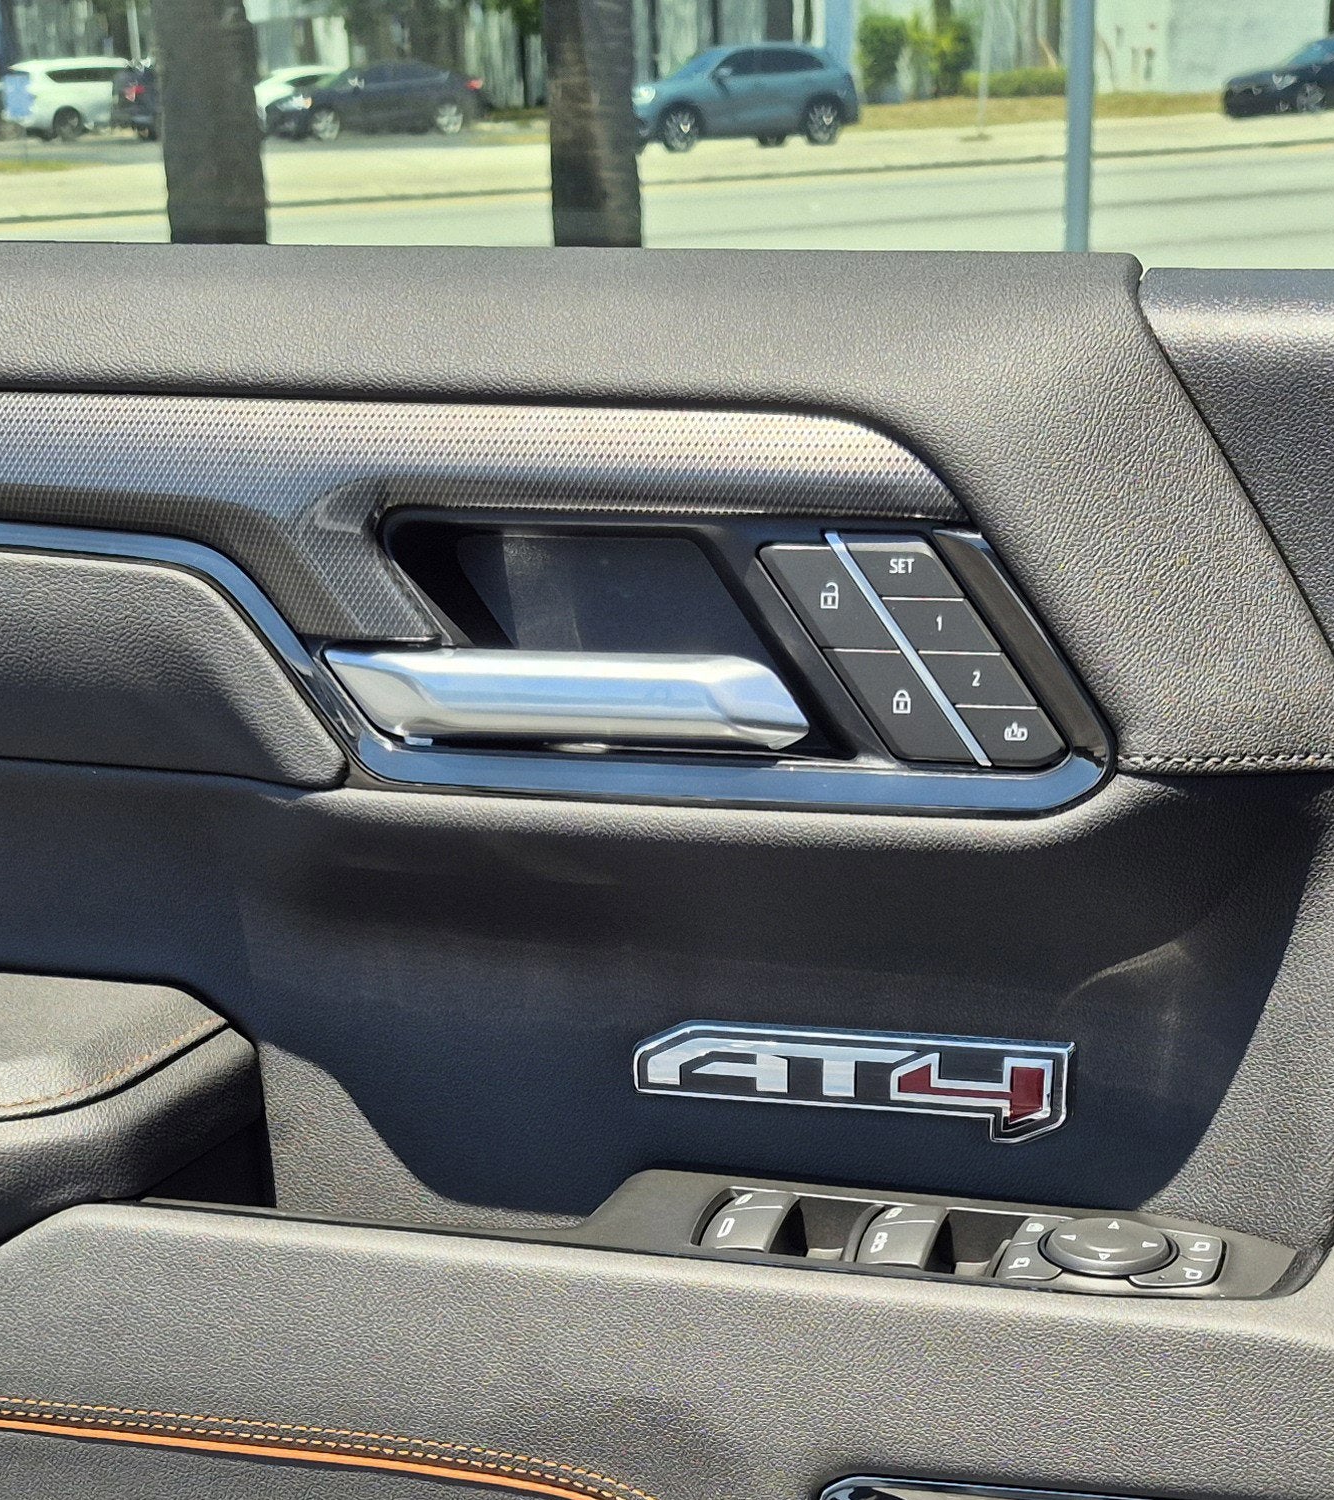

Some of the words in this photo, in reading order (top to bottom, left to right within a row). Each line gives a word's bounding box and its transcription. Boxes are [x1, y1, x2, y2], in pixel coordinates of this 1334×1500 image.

[889, 558, 915, 575] SET
[935, 615, 943, 631] 1
[972, 671, 981, 687] 2
[647, 1036, 1055, 1130] AT4
